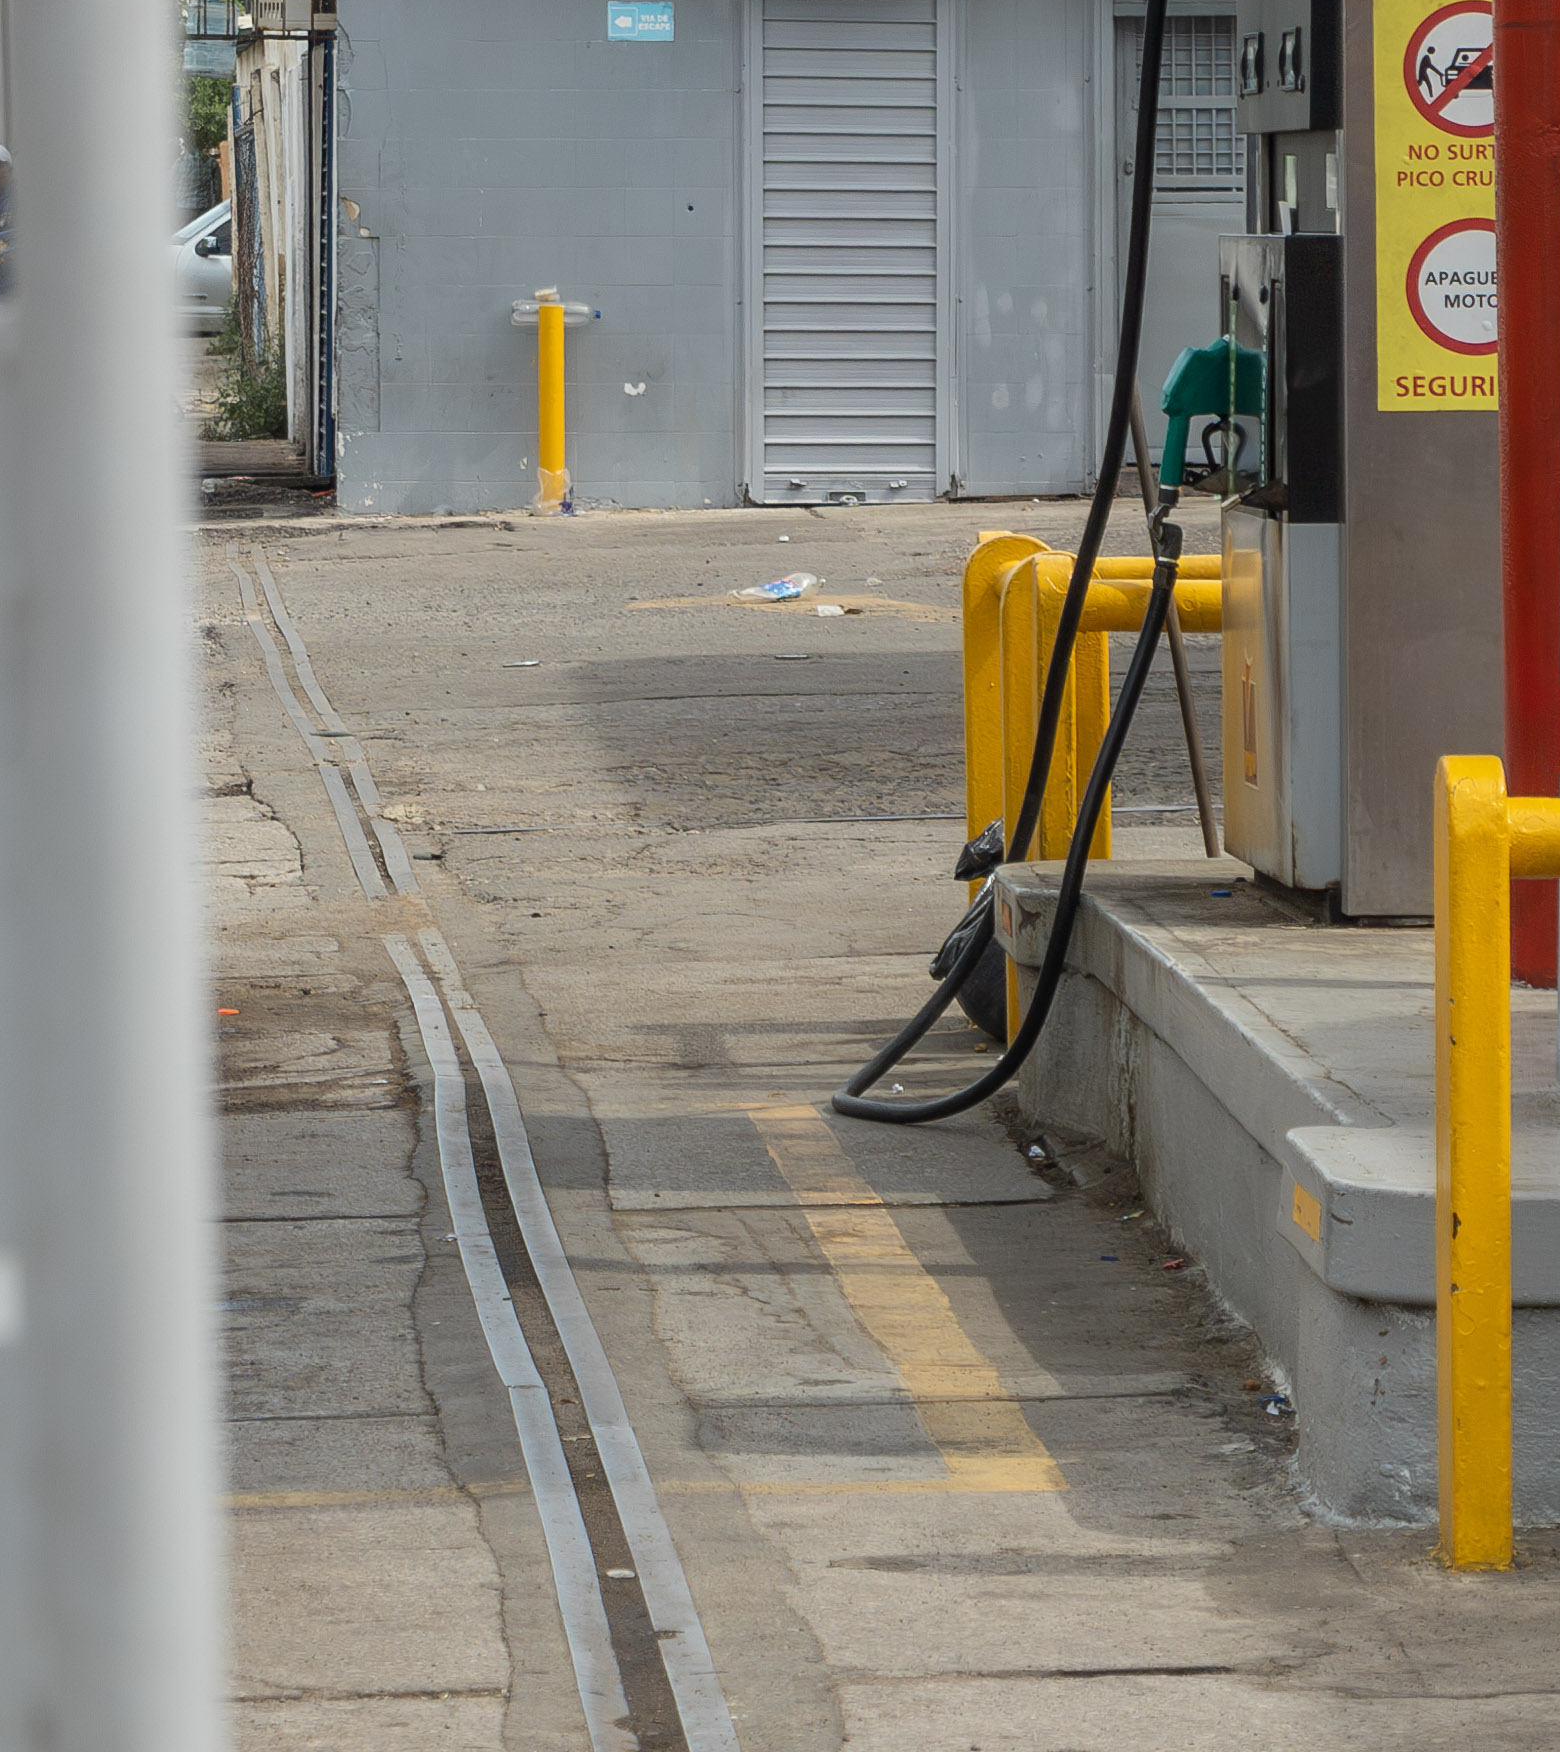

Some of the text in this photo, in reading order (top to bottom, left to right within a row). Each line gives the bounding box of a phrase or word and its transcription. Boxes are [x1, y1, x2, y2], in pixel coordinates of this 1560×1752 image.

[1408, 144, 1439, 161] NO
[1397, 170, 1493, 187] PICO CRU
[1395, 375, 1495, 397] SEGURI
